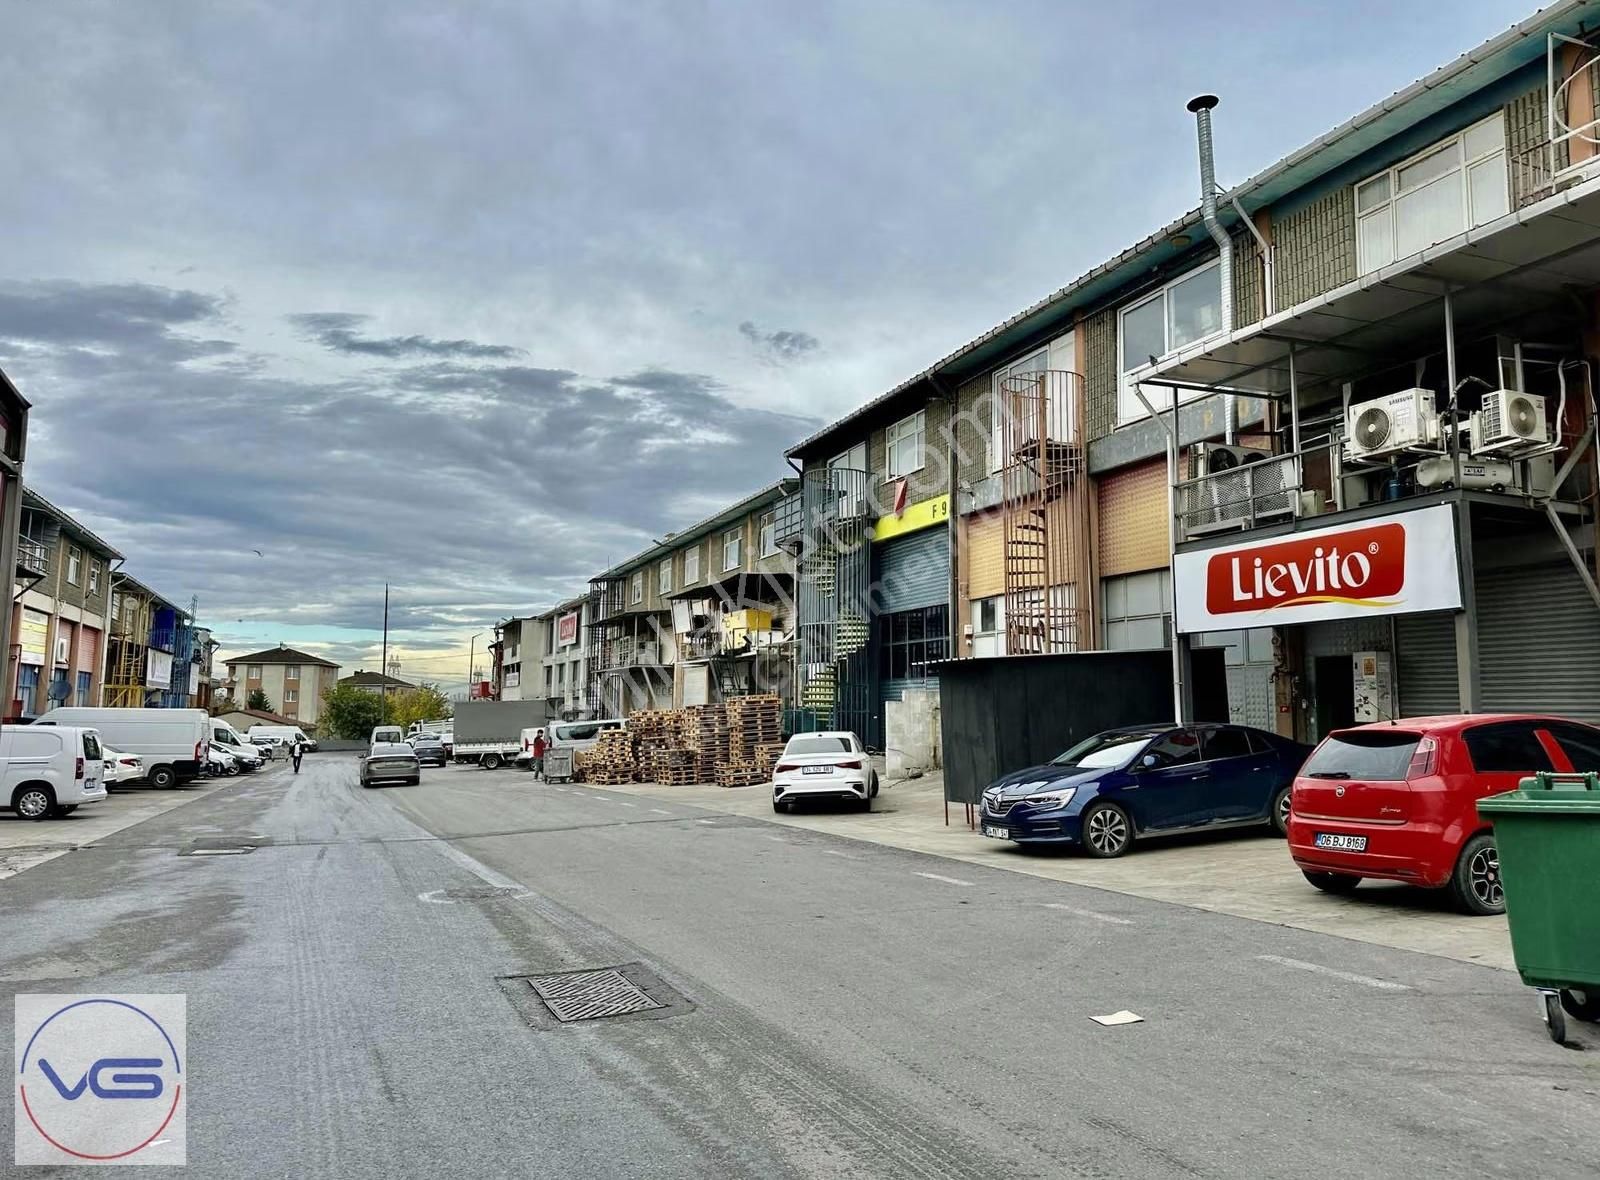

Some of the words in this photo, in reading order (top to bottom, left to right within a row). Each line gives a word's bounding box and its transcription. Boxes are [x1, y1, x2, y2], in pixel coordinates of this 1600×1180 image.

[932, 504, 937, 519] F
[1320, 835, 1332, 846] 06
[1332, 836, 1346, 847] BJ
[1346, 837, 1365, 849] 8168
